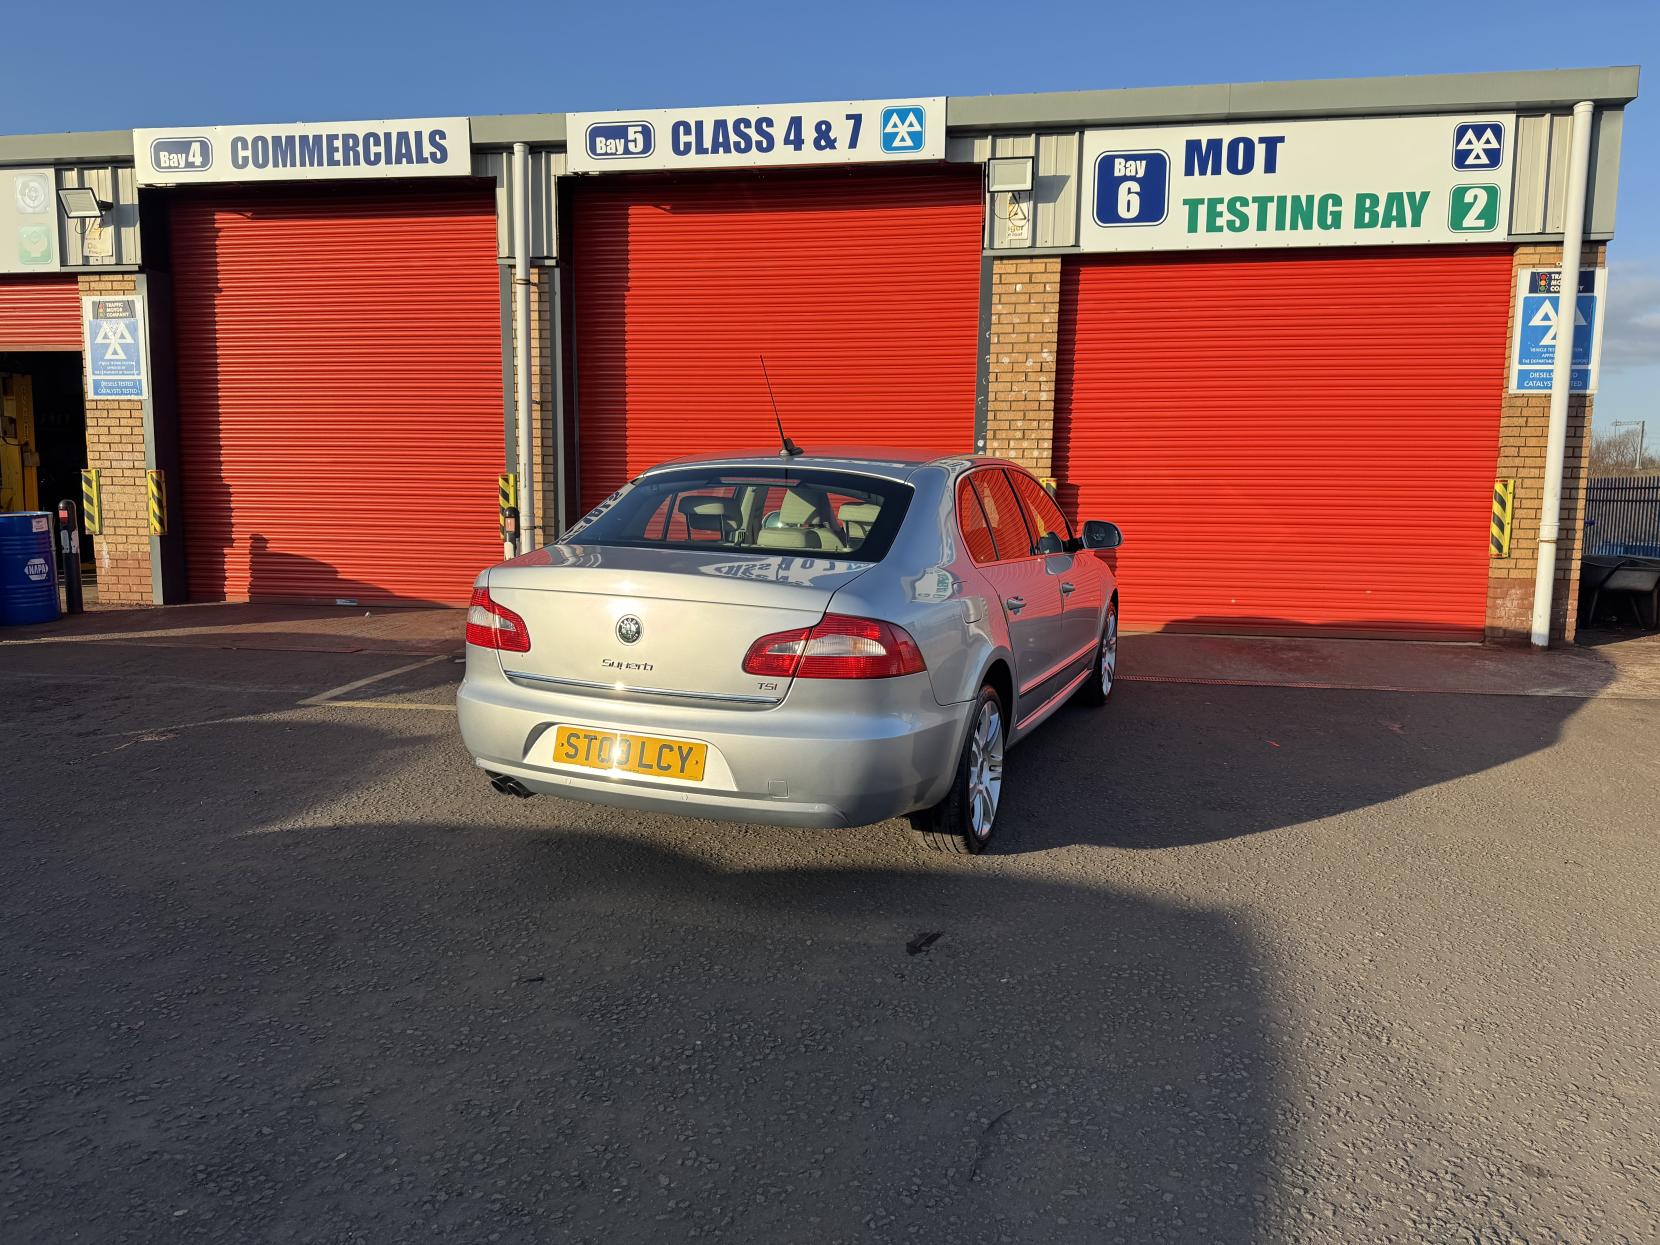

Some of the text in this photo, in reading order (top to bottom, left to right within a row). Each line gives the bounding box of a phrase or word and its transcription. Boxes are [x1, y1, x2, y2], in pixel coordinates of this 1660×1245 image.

[230, 129, 448, 169] COMMERCIALS
[595, 126, 644, 155] Bay 5
[671, 113, 863, 156] CLASS 4 & 7
[160, 142, 203, 168] Bay 4
[1113, 157, 1146, 178] Bay
[1184, 136, 1286, 177] MOT
[1117, 180, 1140, 219] 6
[1182, 191, 1431, 234] TESTING BAY
[1462, 188, 1489, 228] 2
[28, 563, 46, 575] NAPA
[757, 682, 778, 691] TSI
[637, 741, 694, 774] LCY
